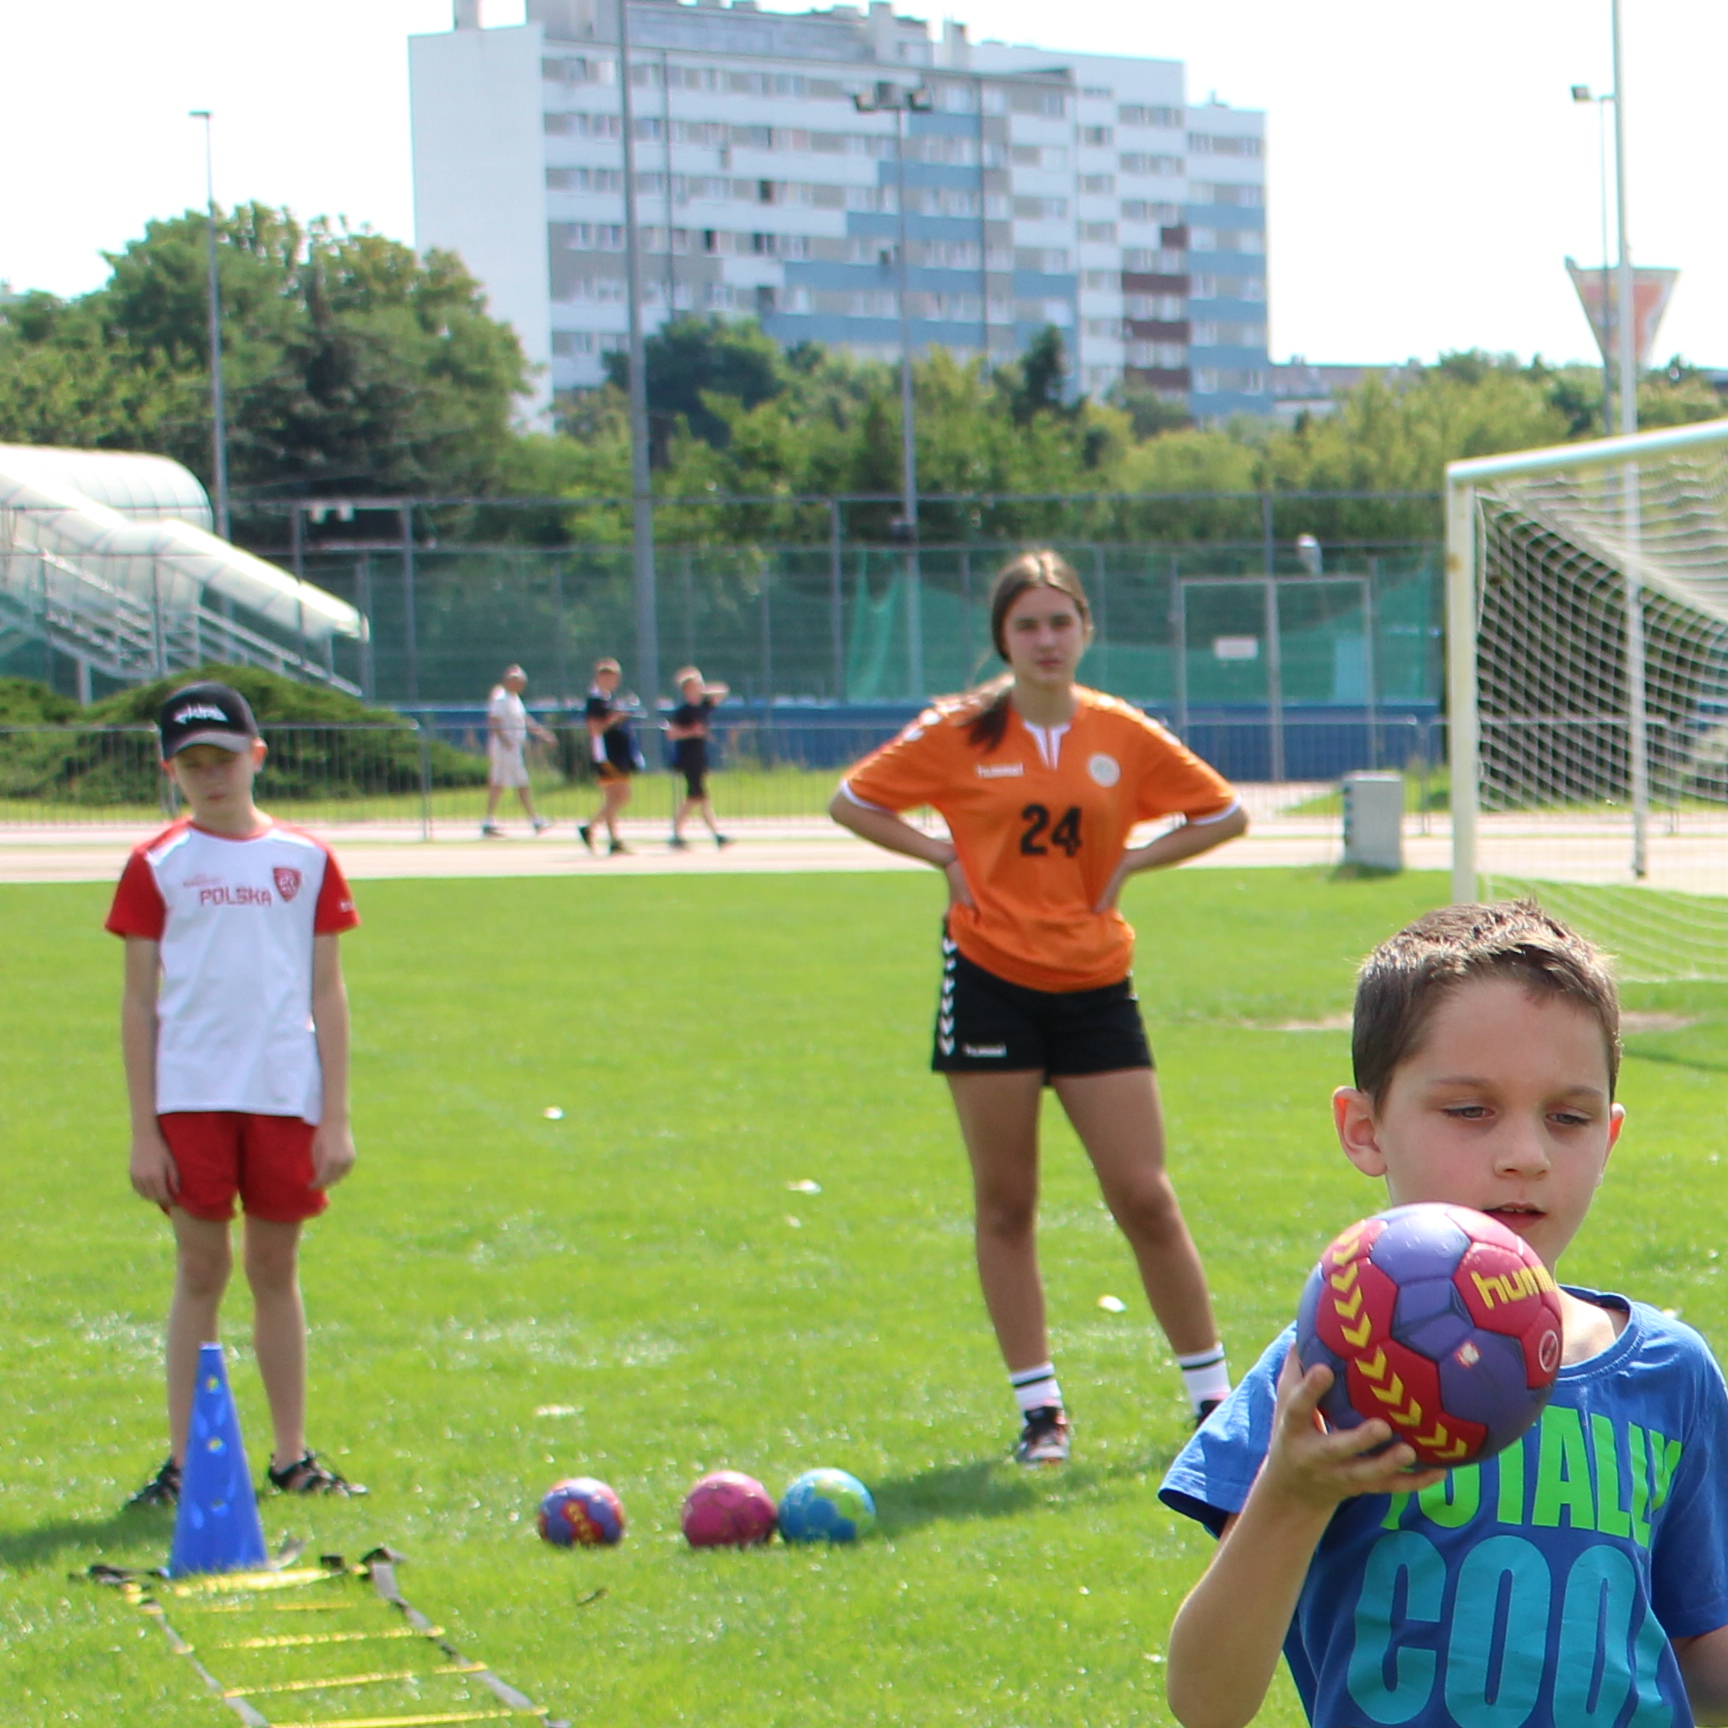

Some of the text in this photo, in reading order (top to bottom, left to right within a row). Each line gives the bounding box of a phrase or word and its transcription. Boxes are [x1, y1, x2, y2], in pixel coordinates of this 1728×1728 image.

[1019, 803, 1084, 857] 24
[200, 885, 273, 907] POLSKA
[1380, 1404, 1683, 1548] TALLY
